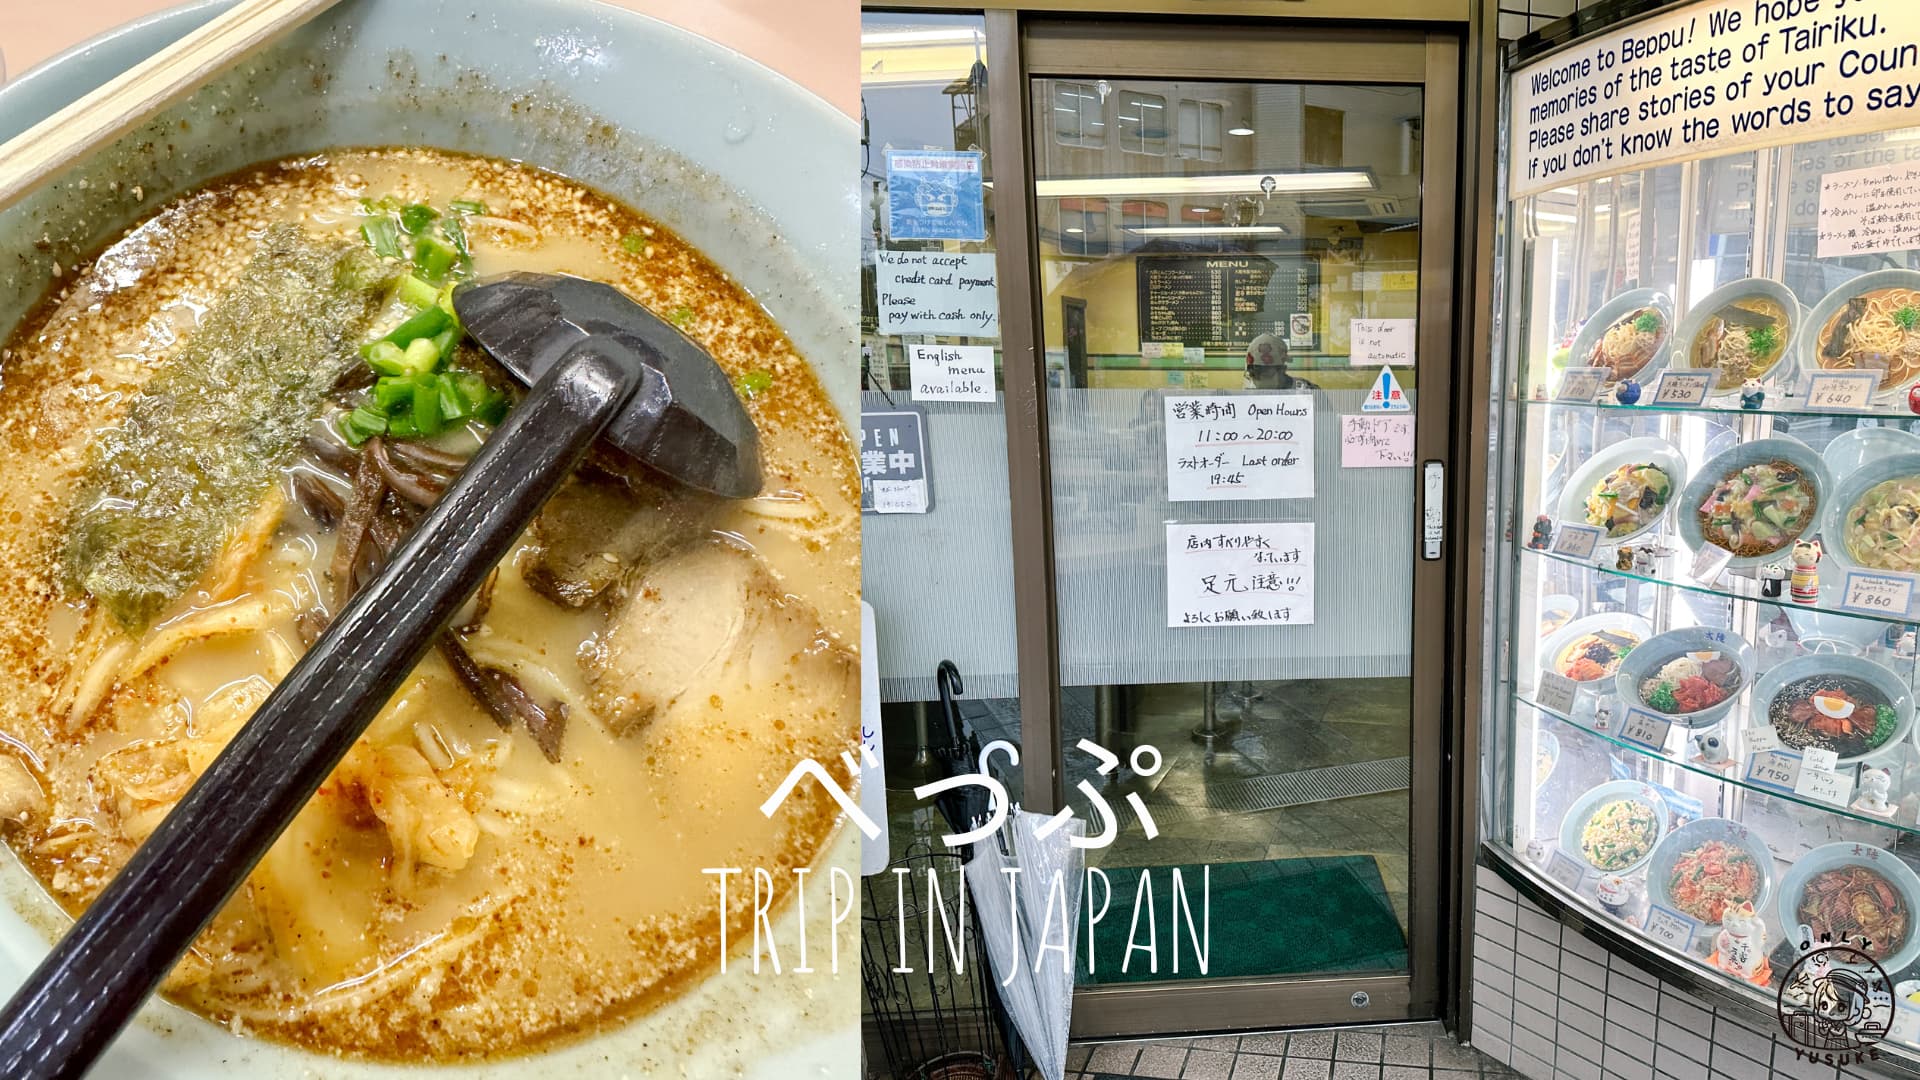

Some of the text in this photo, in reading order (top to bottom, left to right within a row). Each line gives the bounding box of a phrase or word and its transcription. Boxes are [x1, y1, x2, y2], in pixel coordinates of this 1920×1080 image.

[1531, 58, 1591, 97] Welcome
[1597, 49, 1615, 72] to
[1621, 17, 1696, 64] Beppu!
[1709, 9, 1742, 38] We
[1530, 14, 1886, 125] memories of the taste of Tairiku.
[1529, 44, 1917, 152] Please share stories of your Coun
[1528, 82, 1920, 180] If you don't know the words to say
[879, 252, 968, 270] We do not accept
[1206, 260, 1249, 268] MENU
[929, 273, 952, 286] card
[882, 293, 916, 306] Please
[888, 308, 997, 328] pay with cash only.
[1355, 322, 1394, 333] This door
[917, 349, 963, 366] English
[948, 366, 986, 375] menu
[920, 381, 988, 394] available.
[1173, 401, 1308, 420] 営業時間 Open Hours
[1177, 451, 1300, 469] ラストオーダー Last order
[1210, 472, 1245, 484] 19:45
[1187, 534, 1270, 549] 店内すべりやすく
[1254, 548, 1301, 563] なっています
[1852, 591, 1892, 607] ¥860
[1183, 607, 1292, 623] よろしくお願い致します
[1754, 765, 1790, 782] ¥750
